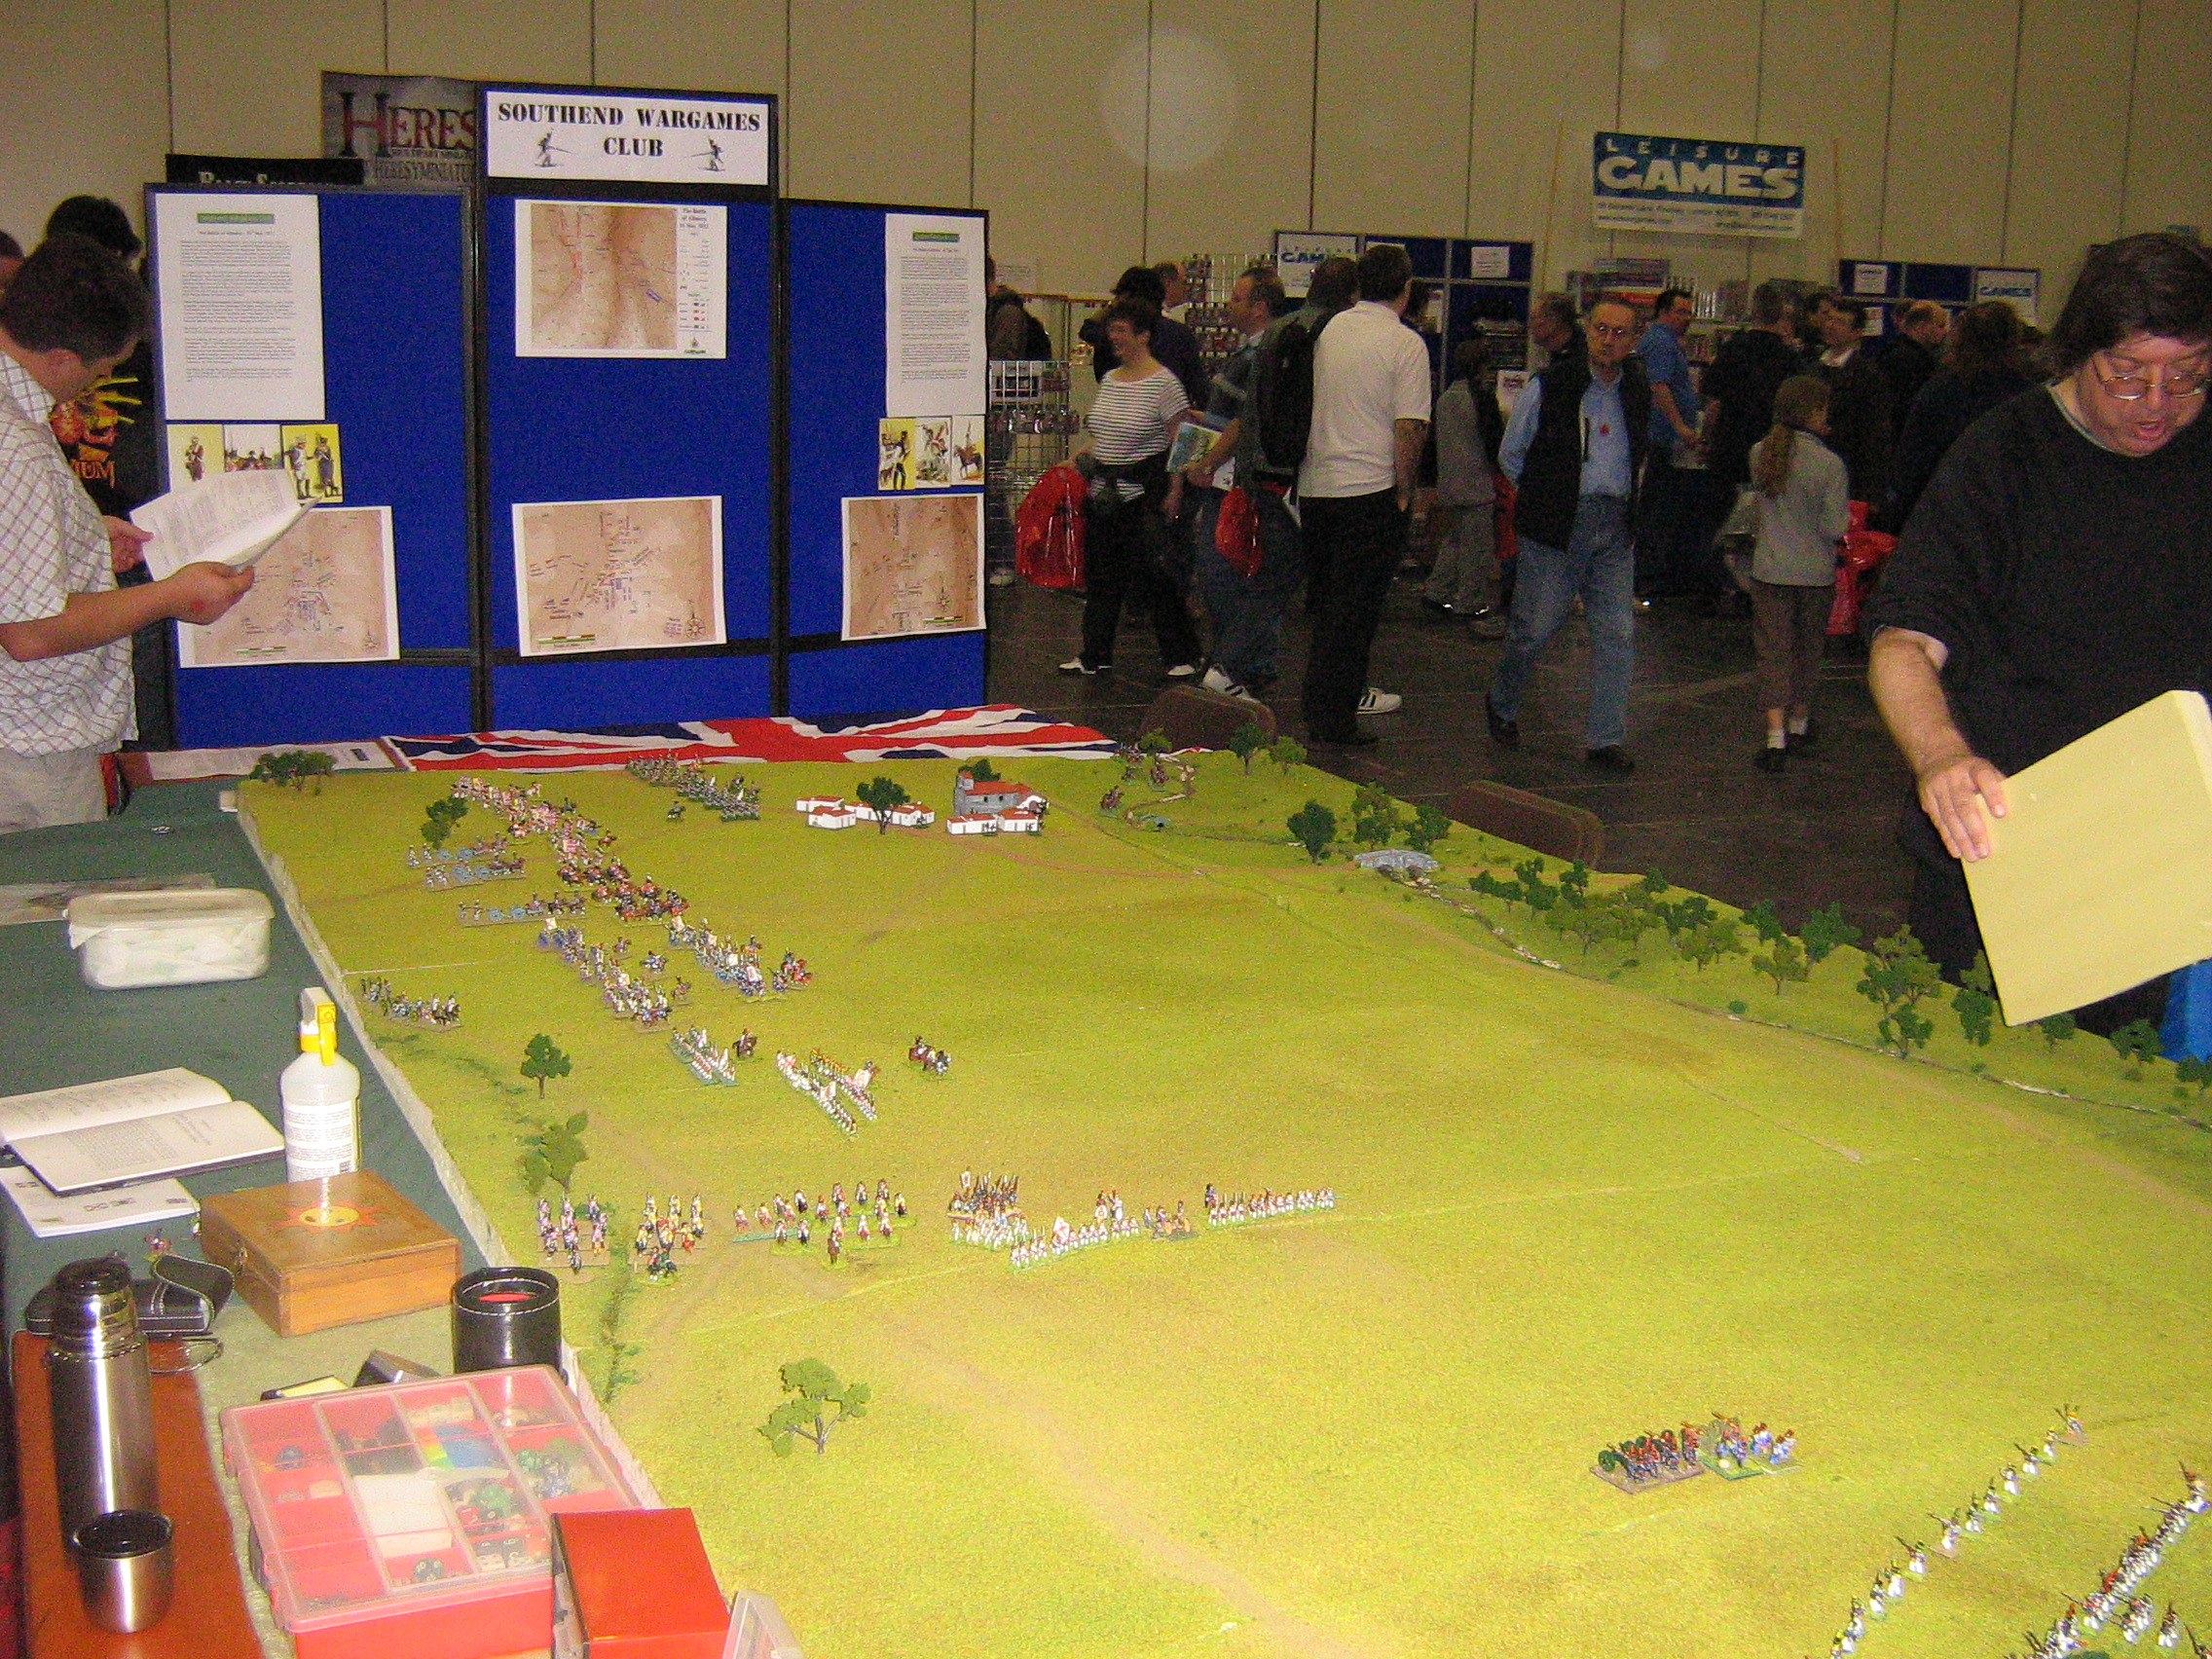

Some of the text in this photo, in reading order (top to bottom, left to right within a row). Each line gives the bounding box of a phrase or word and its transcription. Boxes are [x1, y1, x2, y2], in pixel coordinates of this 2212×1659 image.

[498, 102, 760, 131] SOUTHEND WARGAMES
[603, 136, 664, 158] CLUB
[1598, 156, 1801, 200] GAMES
